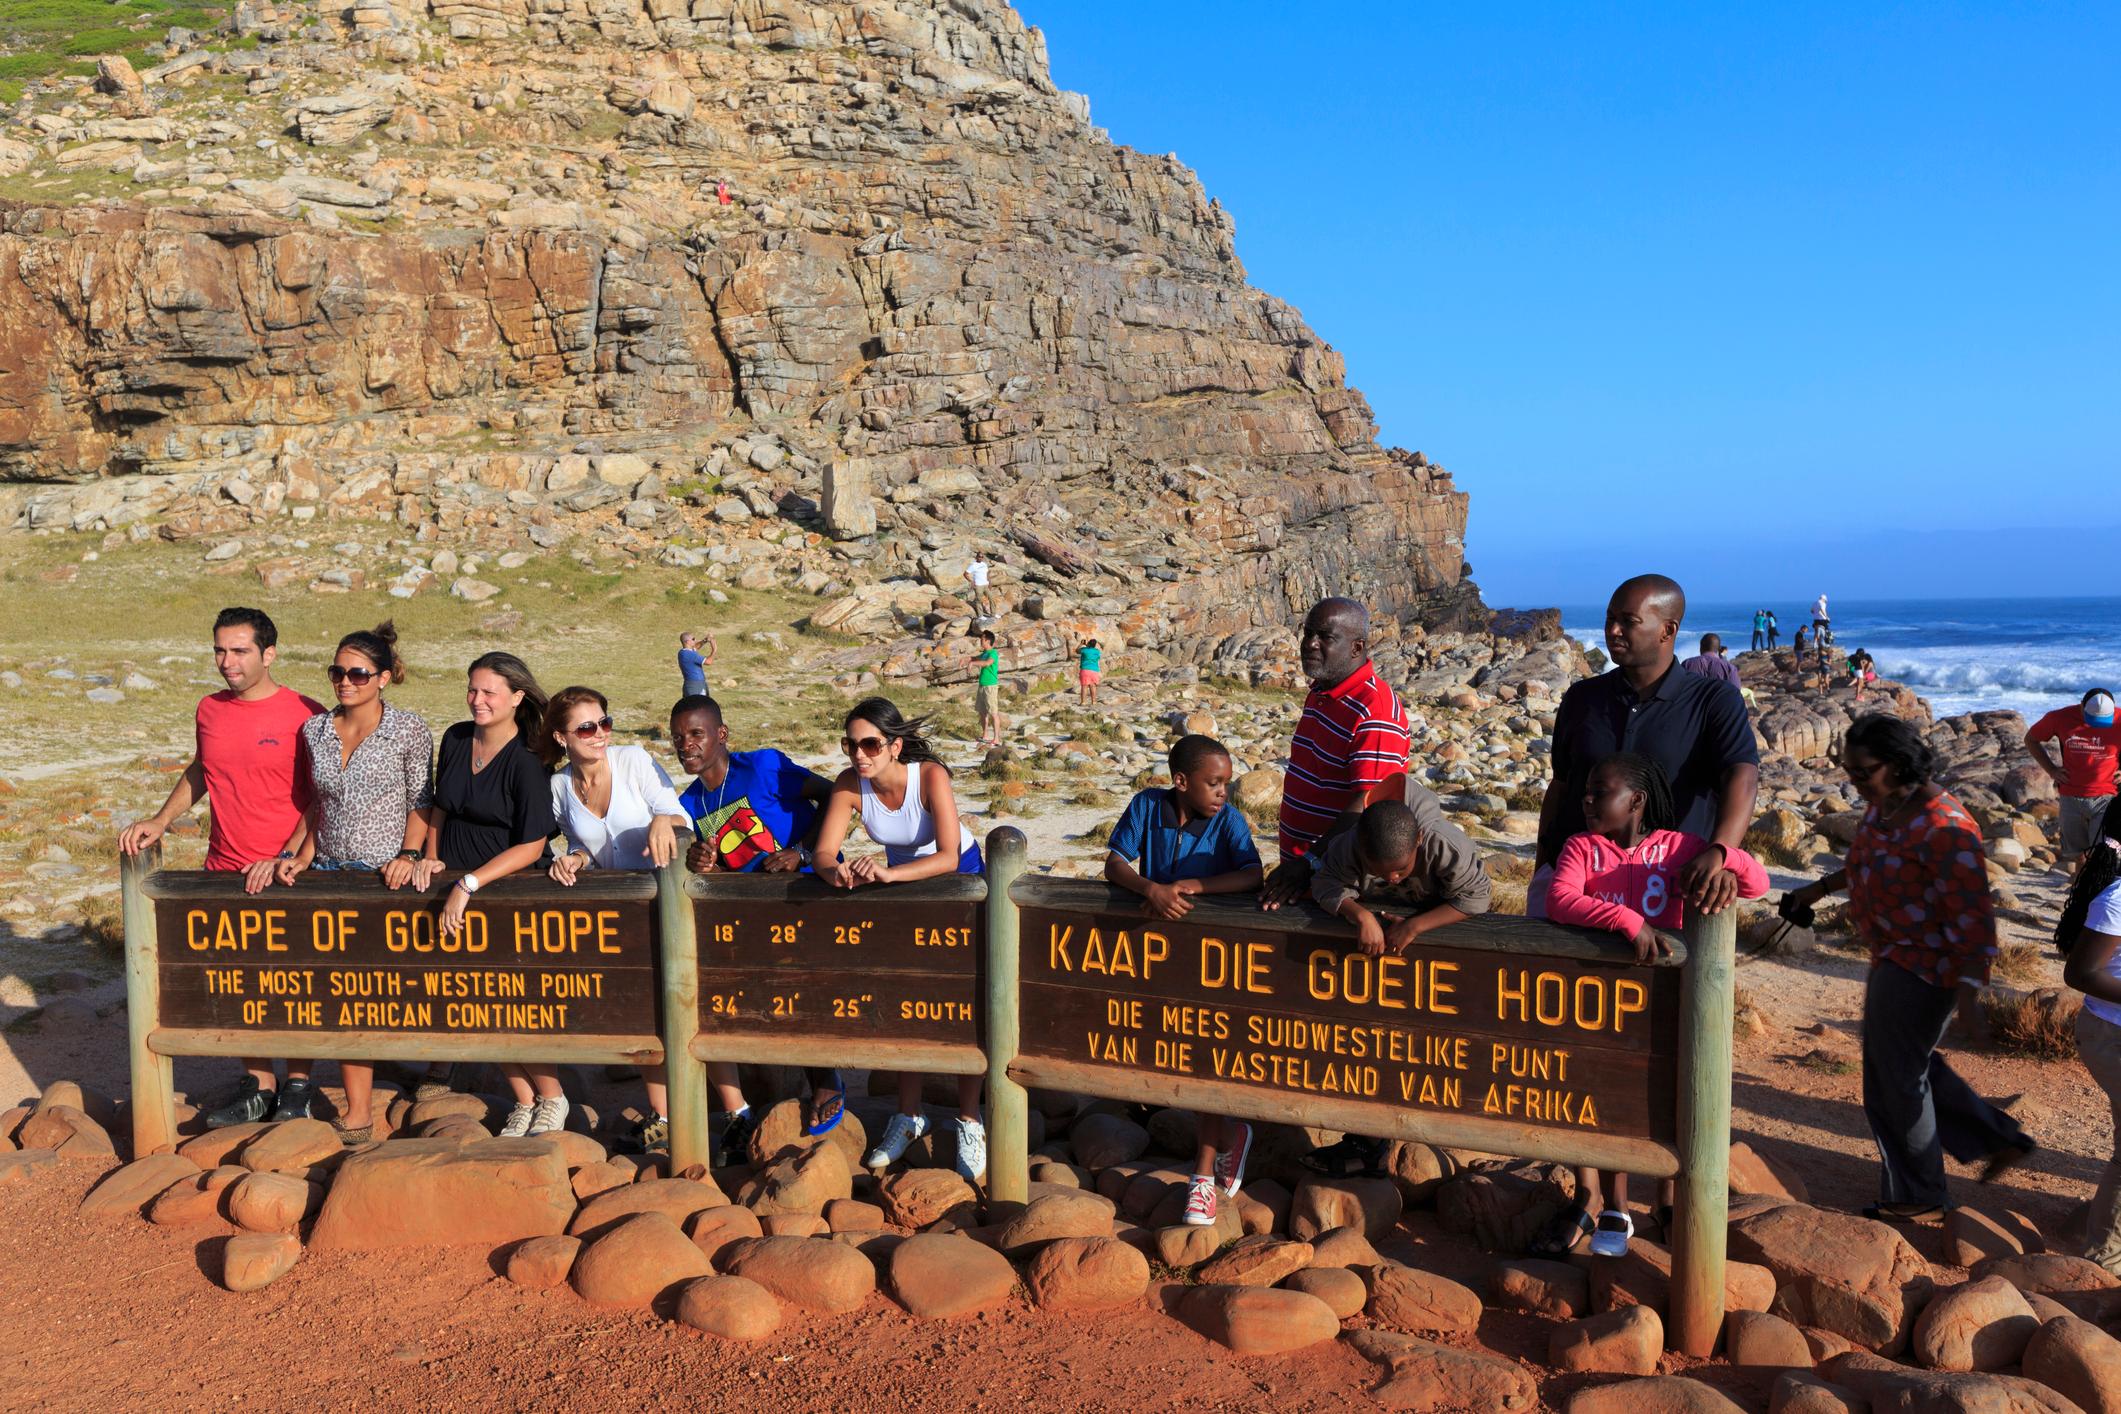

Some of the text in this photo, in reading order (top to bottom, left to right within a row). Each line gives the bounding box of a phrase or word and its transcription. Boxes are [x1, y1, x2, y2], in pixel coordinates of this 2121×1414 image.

[187, 909, 622, 954] CAPE OF GOOD HOPE
[914, 926, 972, 947] EAST
[205, 969, 604, 999] THE MOST SOUTH-WESTERN POINT
[1050, 922, 1649, 1034] KAAP DIE GOEIE HOOP
[242, 999, 569, 1030] OF THE AFRICAN CONTINENT
[900, 1000, 973, 1021] SOUTH
[1106, 997, 1571, 1083] DIE MEES SUIDWESTELIKE PUNT
[1086, 1030, 1599, 1128] VAN DIE VASTELAND VAN AFRIKA
